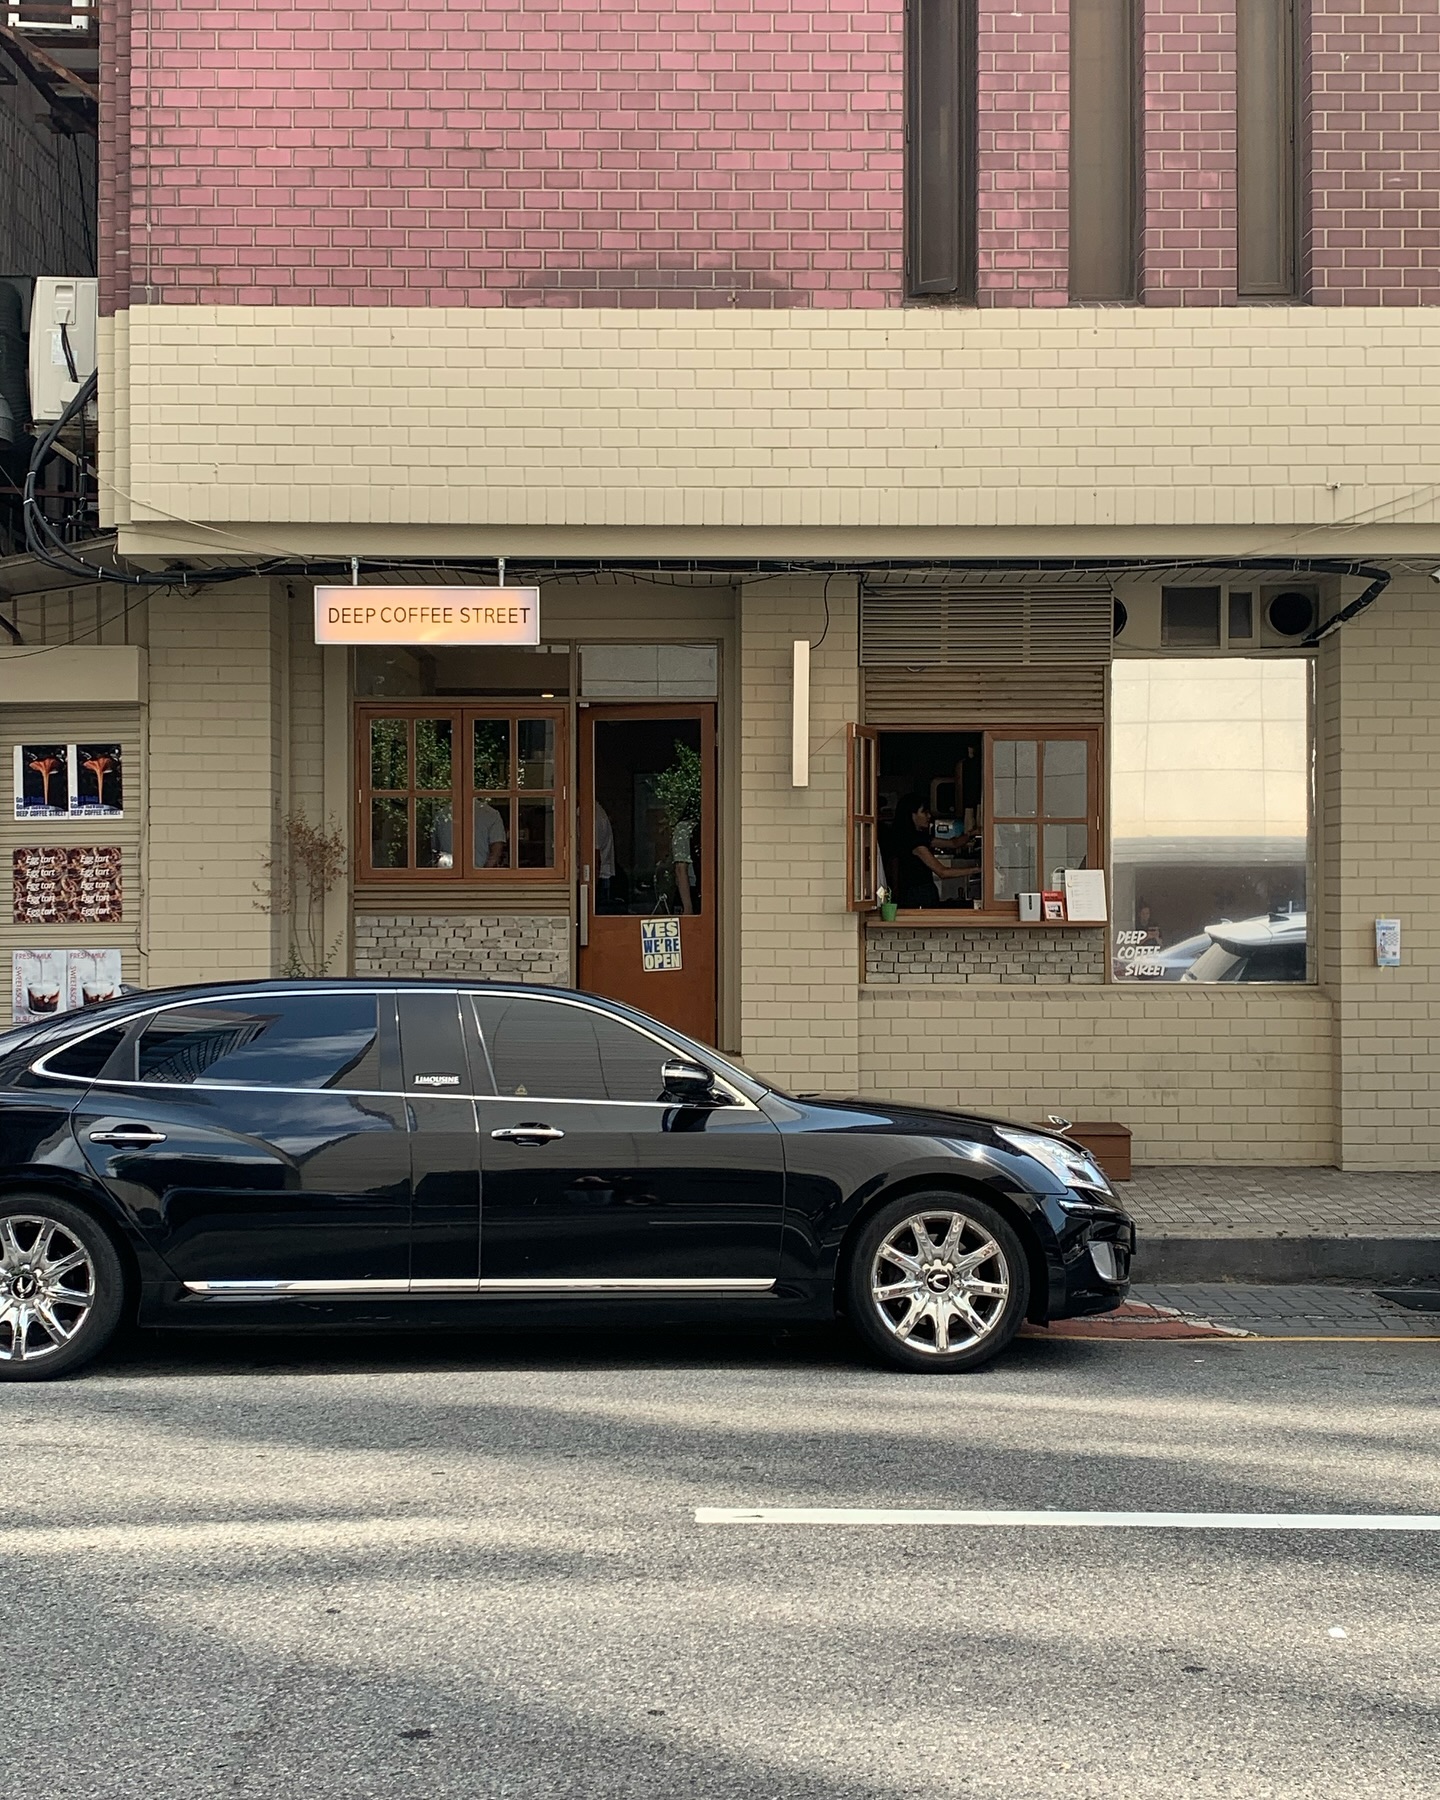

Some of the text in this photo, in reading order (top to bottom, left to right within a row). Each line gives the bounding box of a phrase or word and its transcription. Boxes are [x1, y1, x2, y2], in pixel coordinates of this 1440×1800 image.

[328, 607, 530, 624] DEEP COFFEE STREET
[26, 856, 39, 866] Egg
[80, 856, 94, 865] Egg
[26, 869, 39, 878] Egg
[81, 868, 94, 877] Egg
[27, 882, 39, 891] Egg
[81, 882, 94, 890] Egg
[27, 895, 40, 904] Egg
[81, 895, 94, 903] Egg
[27, 908, 40, 917] Egg
[82, 907, 95, 916] Egg
[643, 922, 678, 938] YES
[1116, 930, 1147, 945] DEEP
[644, 938, 679, 953] WE'RE
[1117, 946, 1161, 960] COFFEE
[645, 954, 680, 969] OPEN
[1125, 964, 1166, 976] STREET
